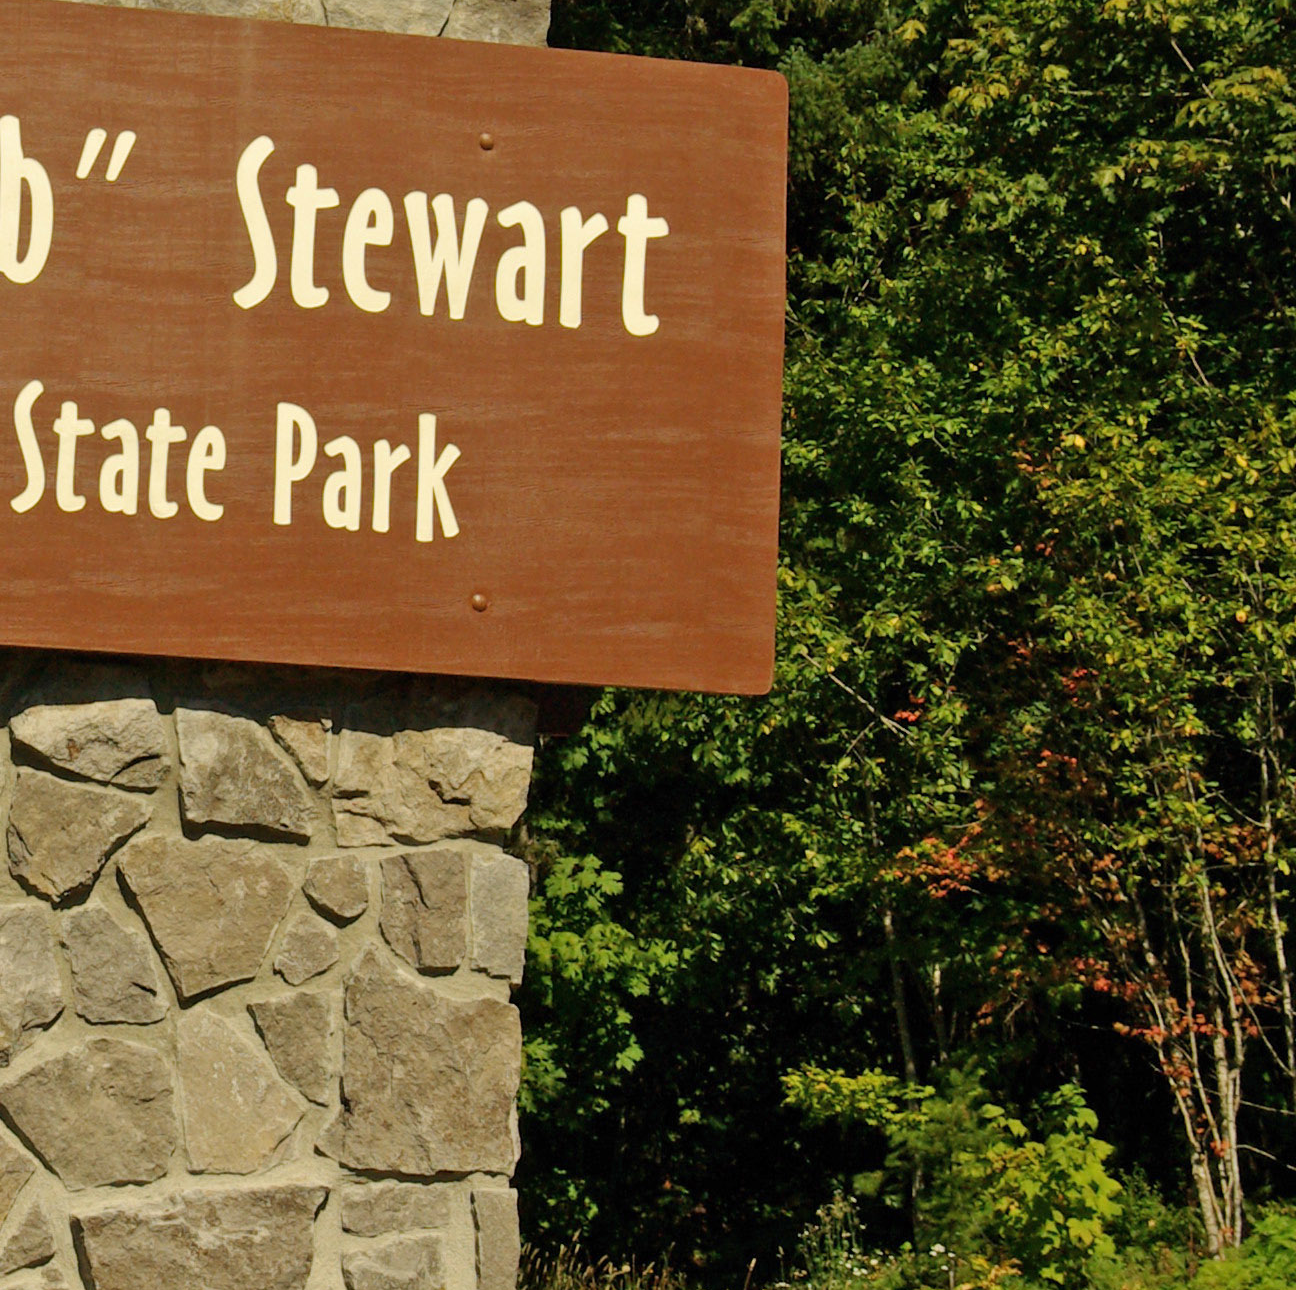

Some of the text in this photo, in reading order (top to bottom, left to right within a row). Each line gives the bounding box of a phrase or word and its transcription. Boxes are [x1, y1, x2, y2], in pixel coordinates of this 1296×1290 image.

[232, 134, 670, 337] Stewart
[10, 379, 461, 542] State Park
